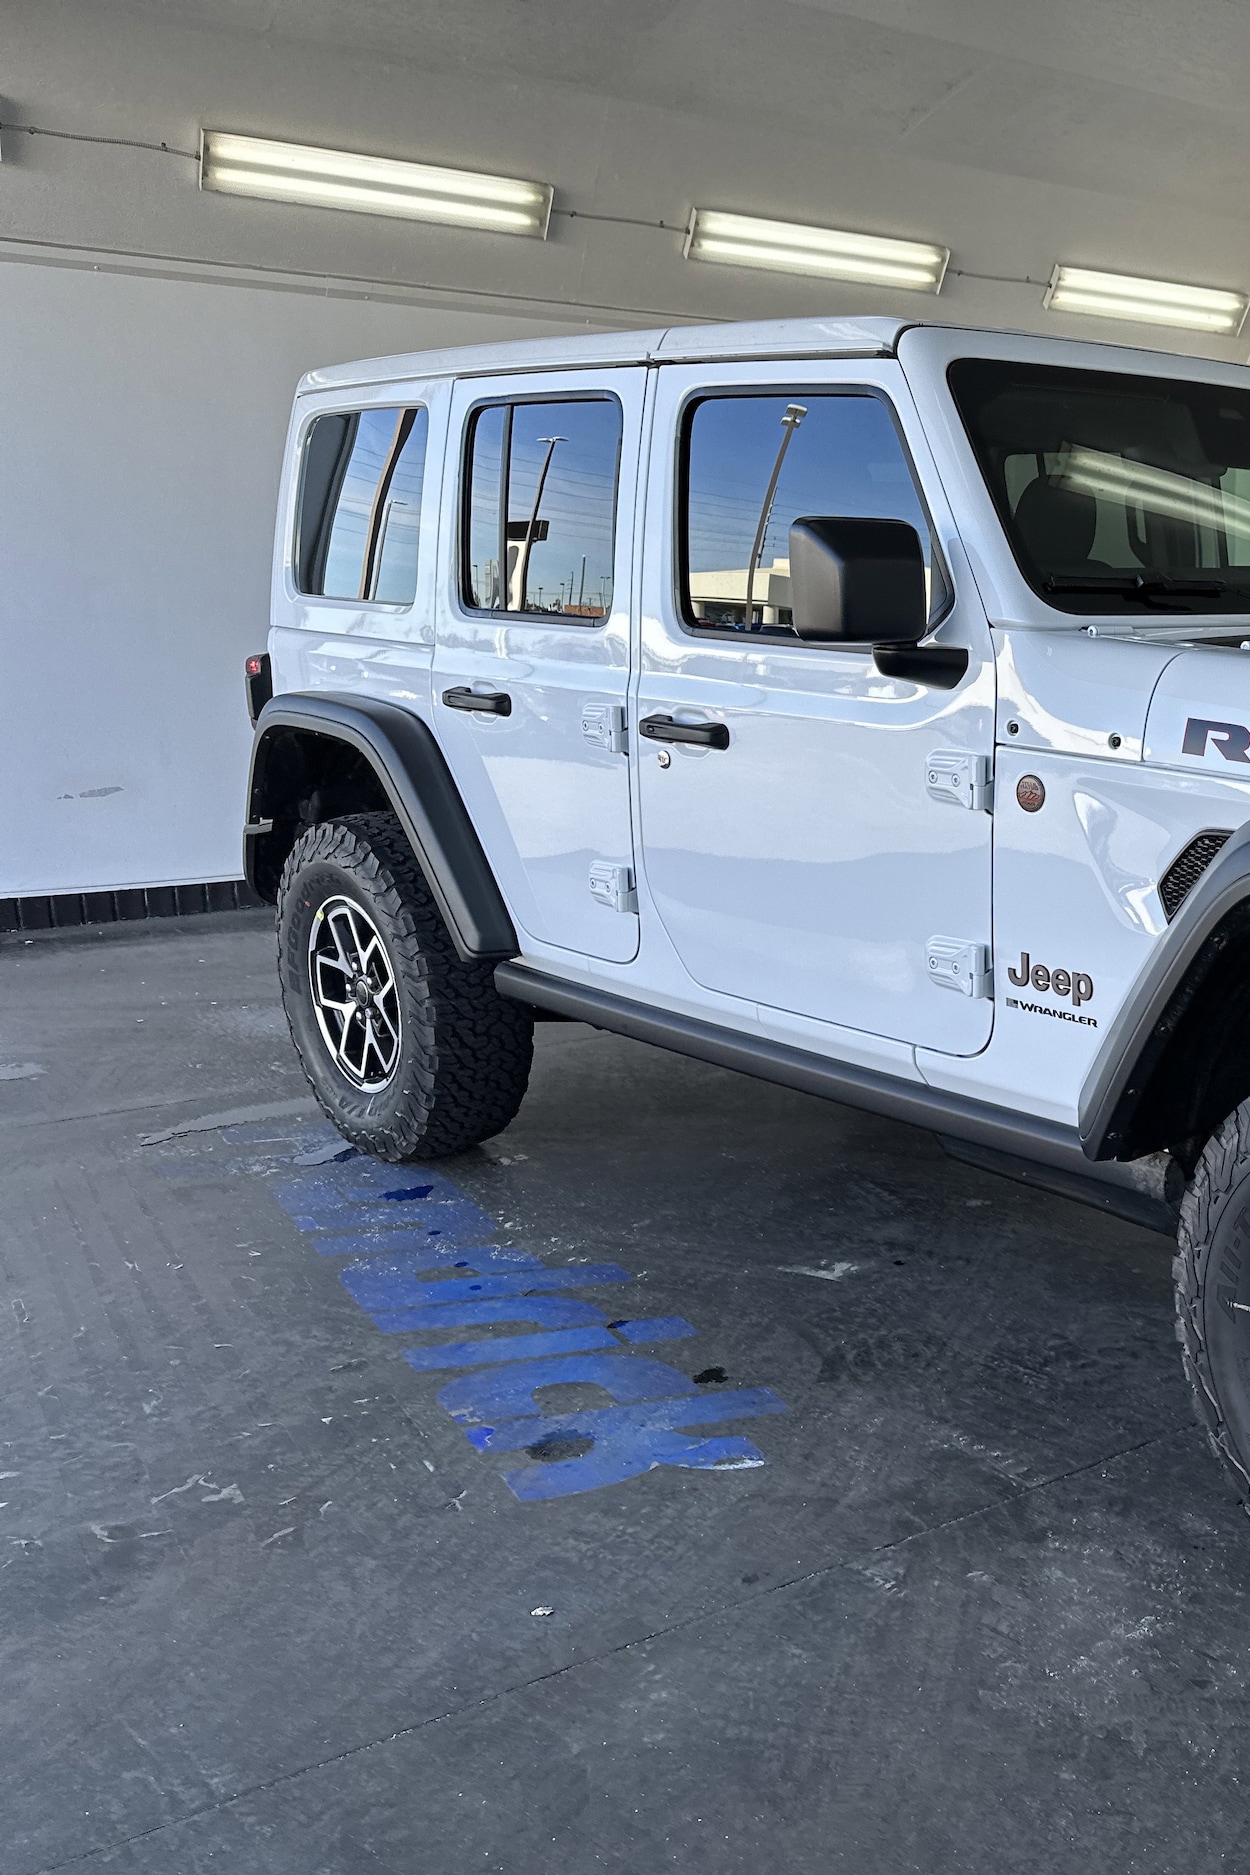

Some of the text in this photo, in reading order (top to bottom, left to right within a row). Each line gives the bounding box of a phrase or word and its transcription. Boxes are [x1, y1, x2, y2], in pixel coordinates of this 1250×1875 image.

[1007, 951, 1094, 1007] Jeep
[1019, 1000, 1098, 1028] WRANGLER
[219, 1122, 792, 1501] endrick
